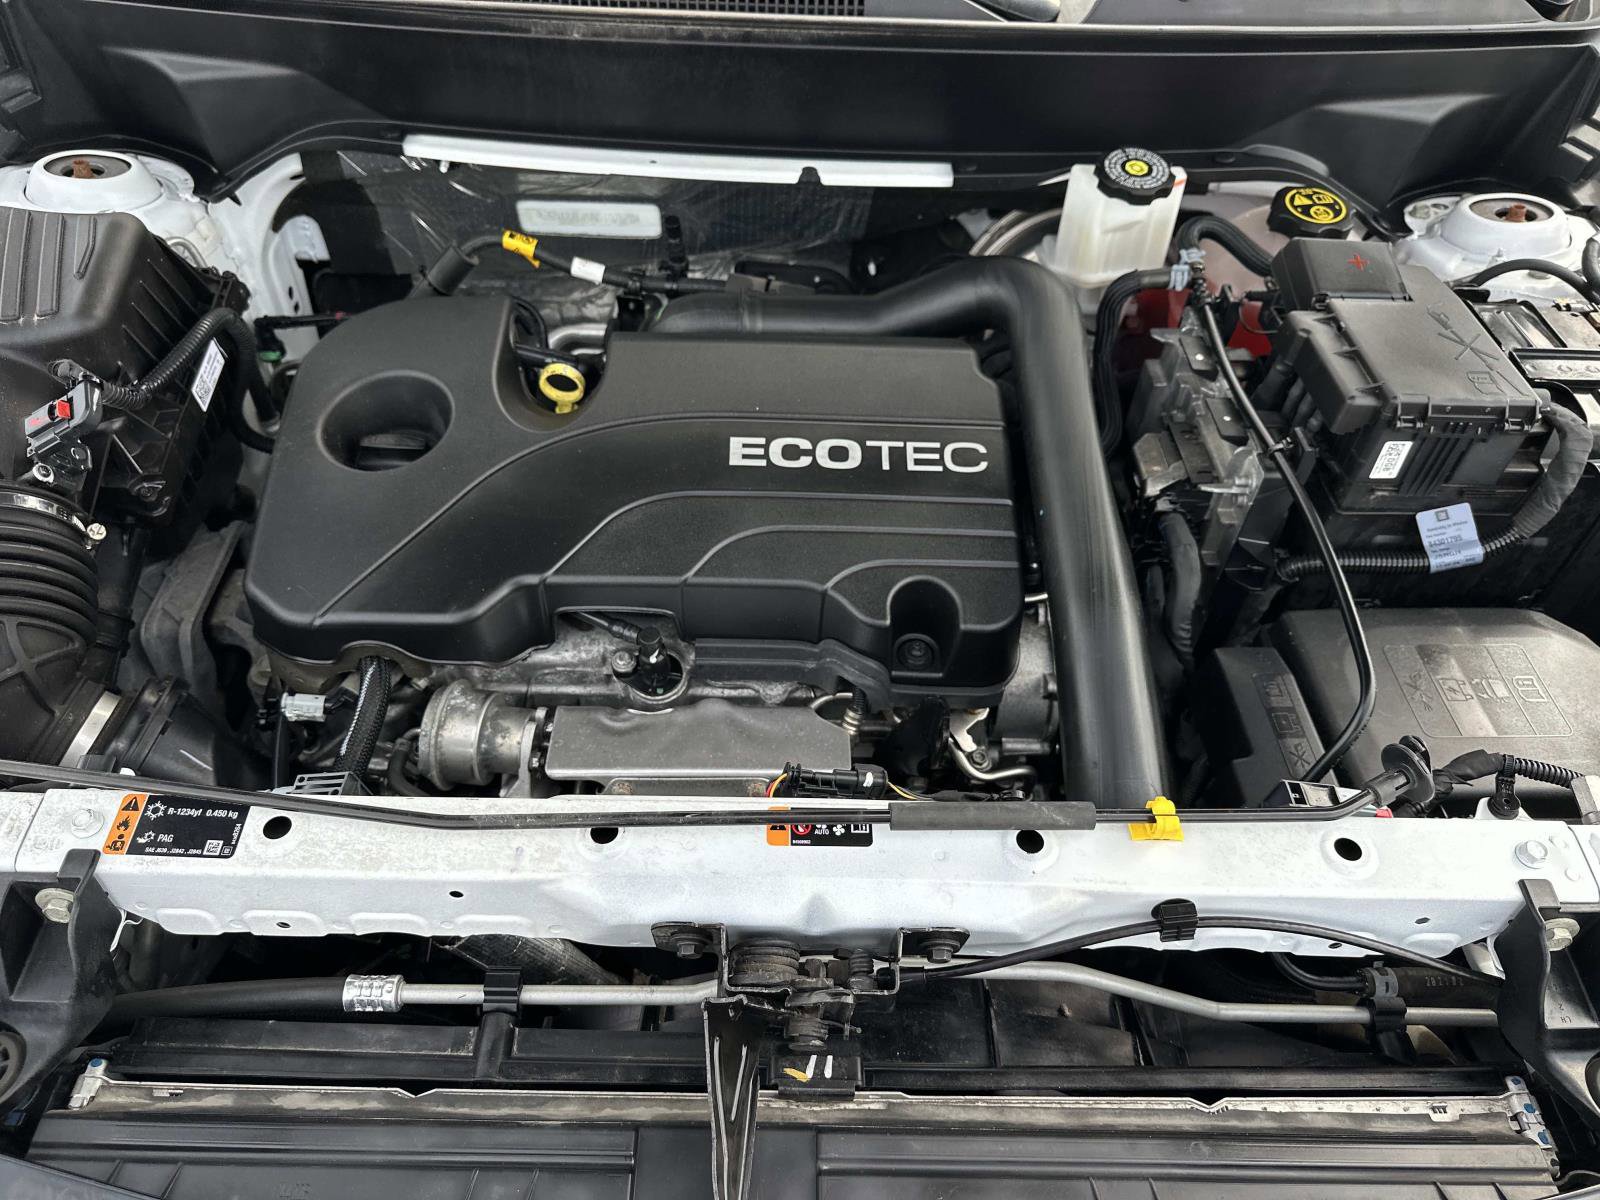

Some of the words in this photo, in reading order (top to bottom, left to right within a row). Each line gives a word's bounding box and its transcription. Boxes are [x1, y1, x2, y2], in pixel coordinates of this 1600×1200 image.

[728, 436, 989, 473] ECOTEC
[167, 807, 203, 817] R-1234yf
[206, 809, 227, 818] 0.450
[228, 810, 239, 819] kg
[157, 834, 174, 843] PAG
